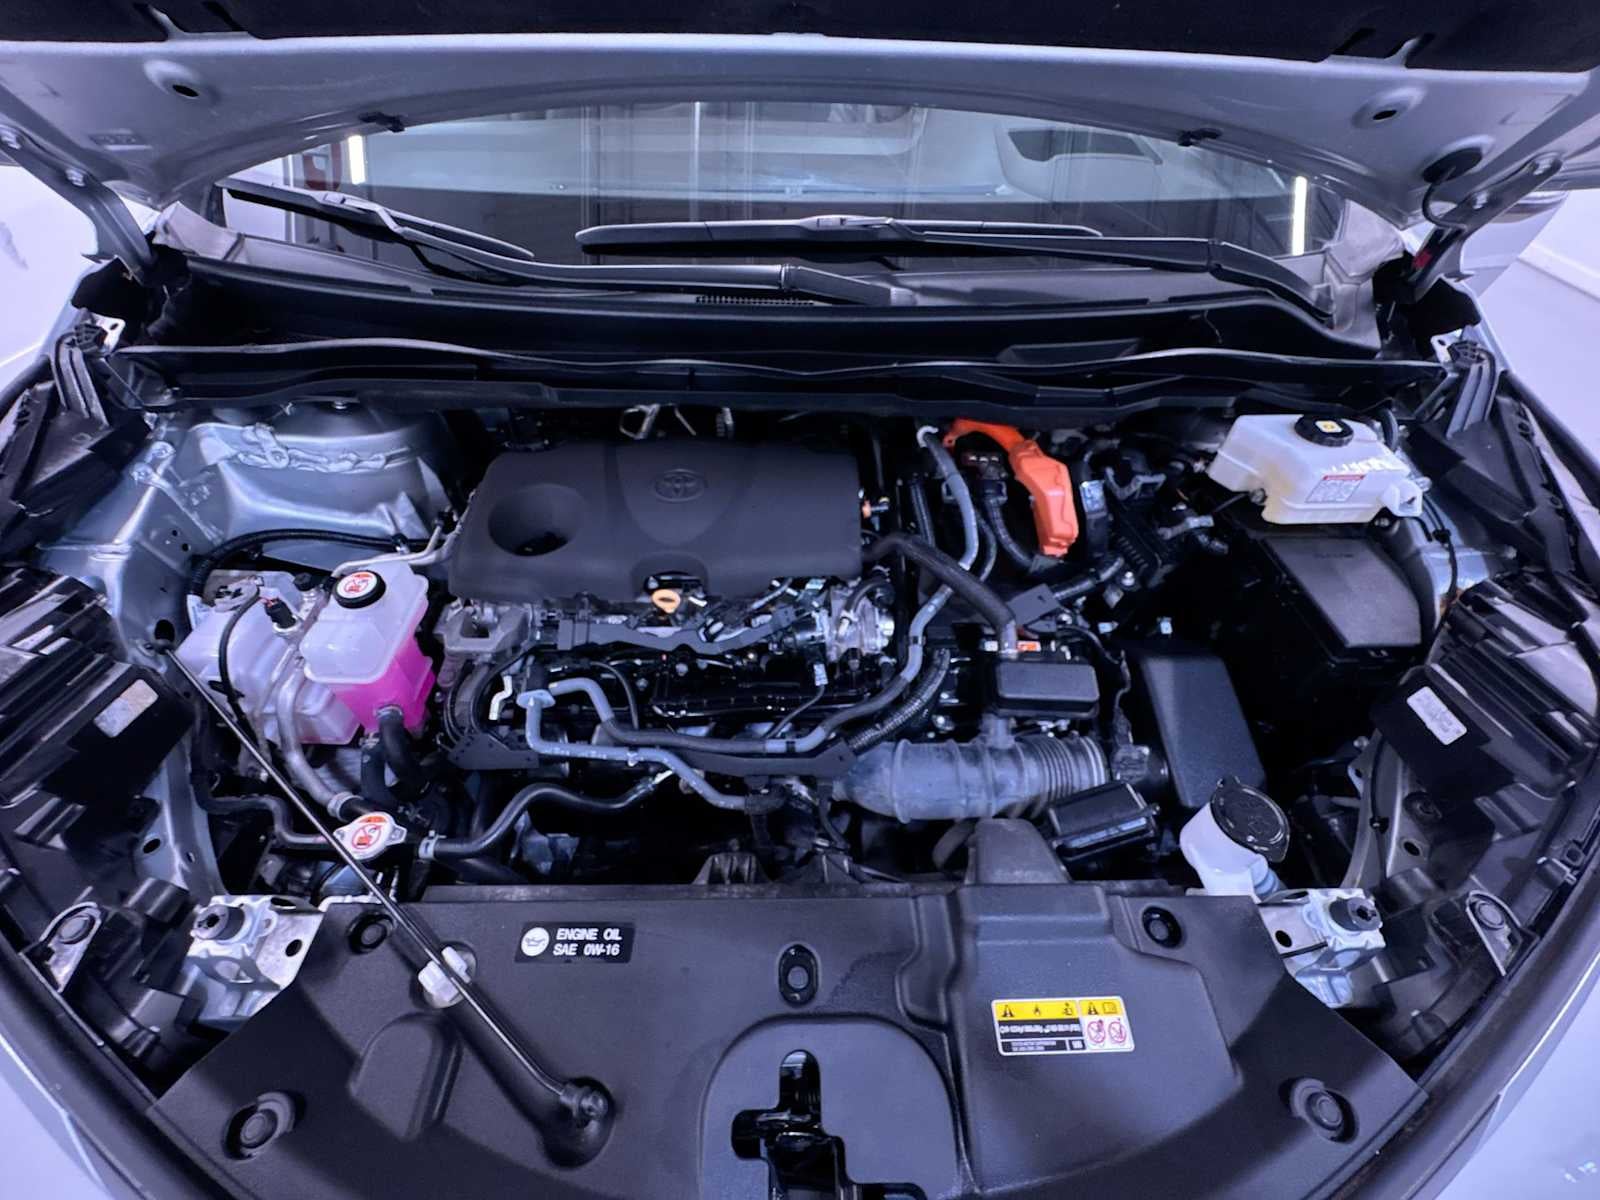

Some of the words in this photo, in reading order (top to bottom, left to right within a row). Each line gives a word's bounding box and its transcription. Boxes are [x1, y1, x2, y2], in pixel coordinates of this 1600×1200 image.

[556, 927, 599, 941] ENGINE
[602, 927, 623, 941] OIL
[552, 943, 579, 956] SAE
[583, 943, 621, 956] 0W-16
